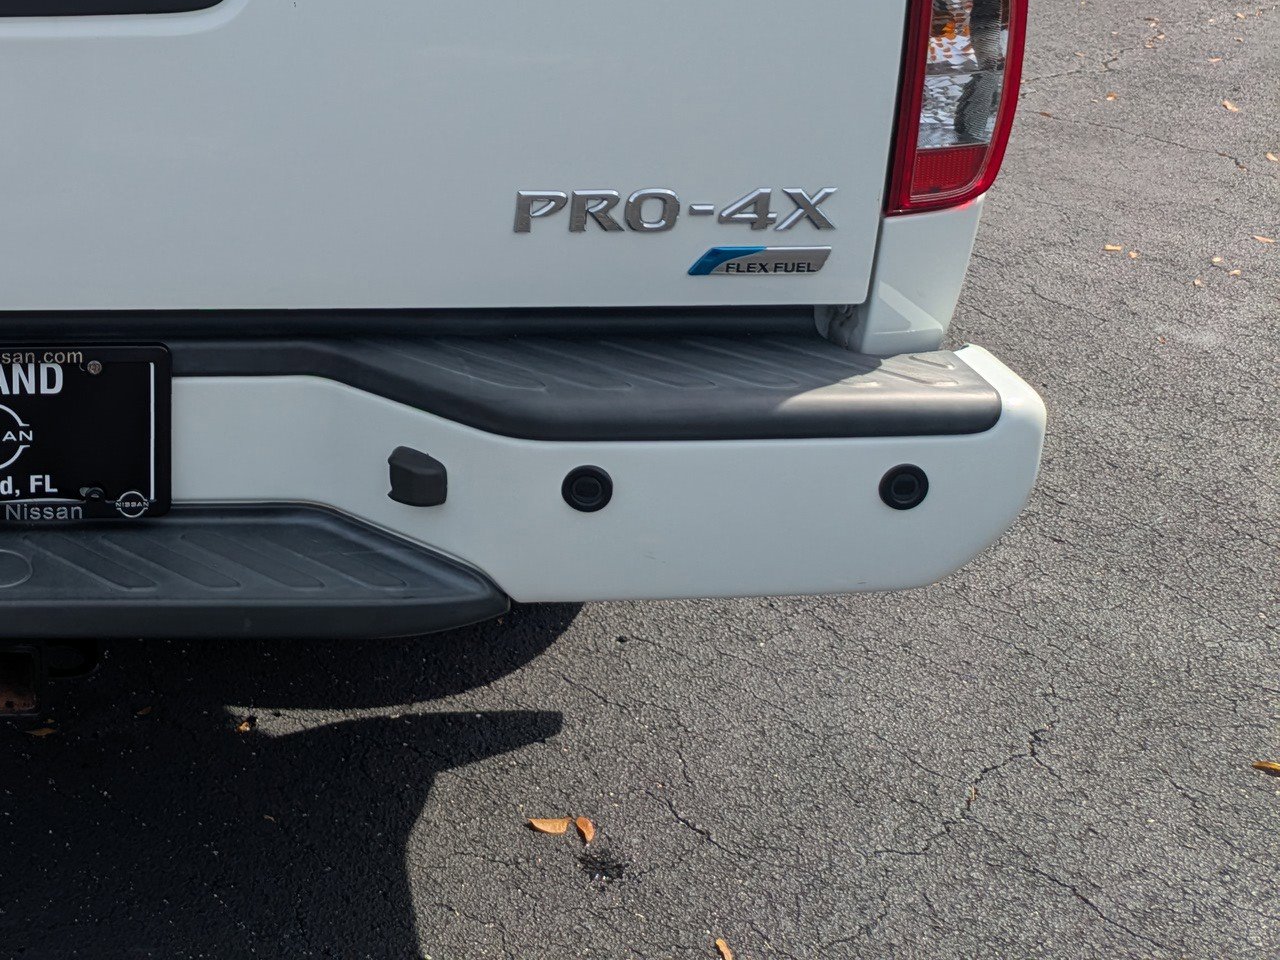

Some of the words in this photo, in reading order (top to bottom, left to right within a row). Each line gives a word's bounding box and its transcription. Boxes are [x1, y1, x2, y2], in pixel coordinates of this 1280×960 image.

[514, 187, 838, 233] PRO-4X
[725, 262, 769, 274] FLEX
[773, 262, 817, 274] FUEL
[29, 475, 58, 493] FL
[5, 504, 83, 521] Nissan
[115, 501, 149, 509] NISSAN
